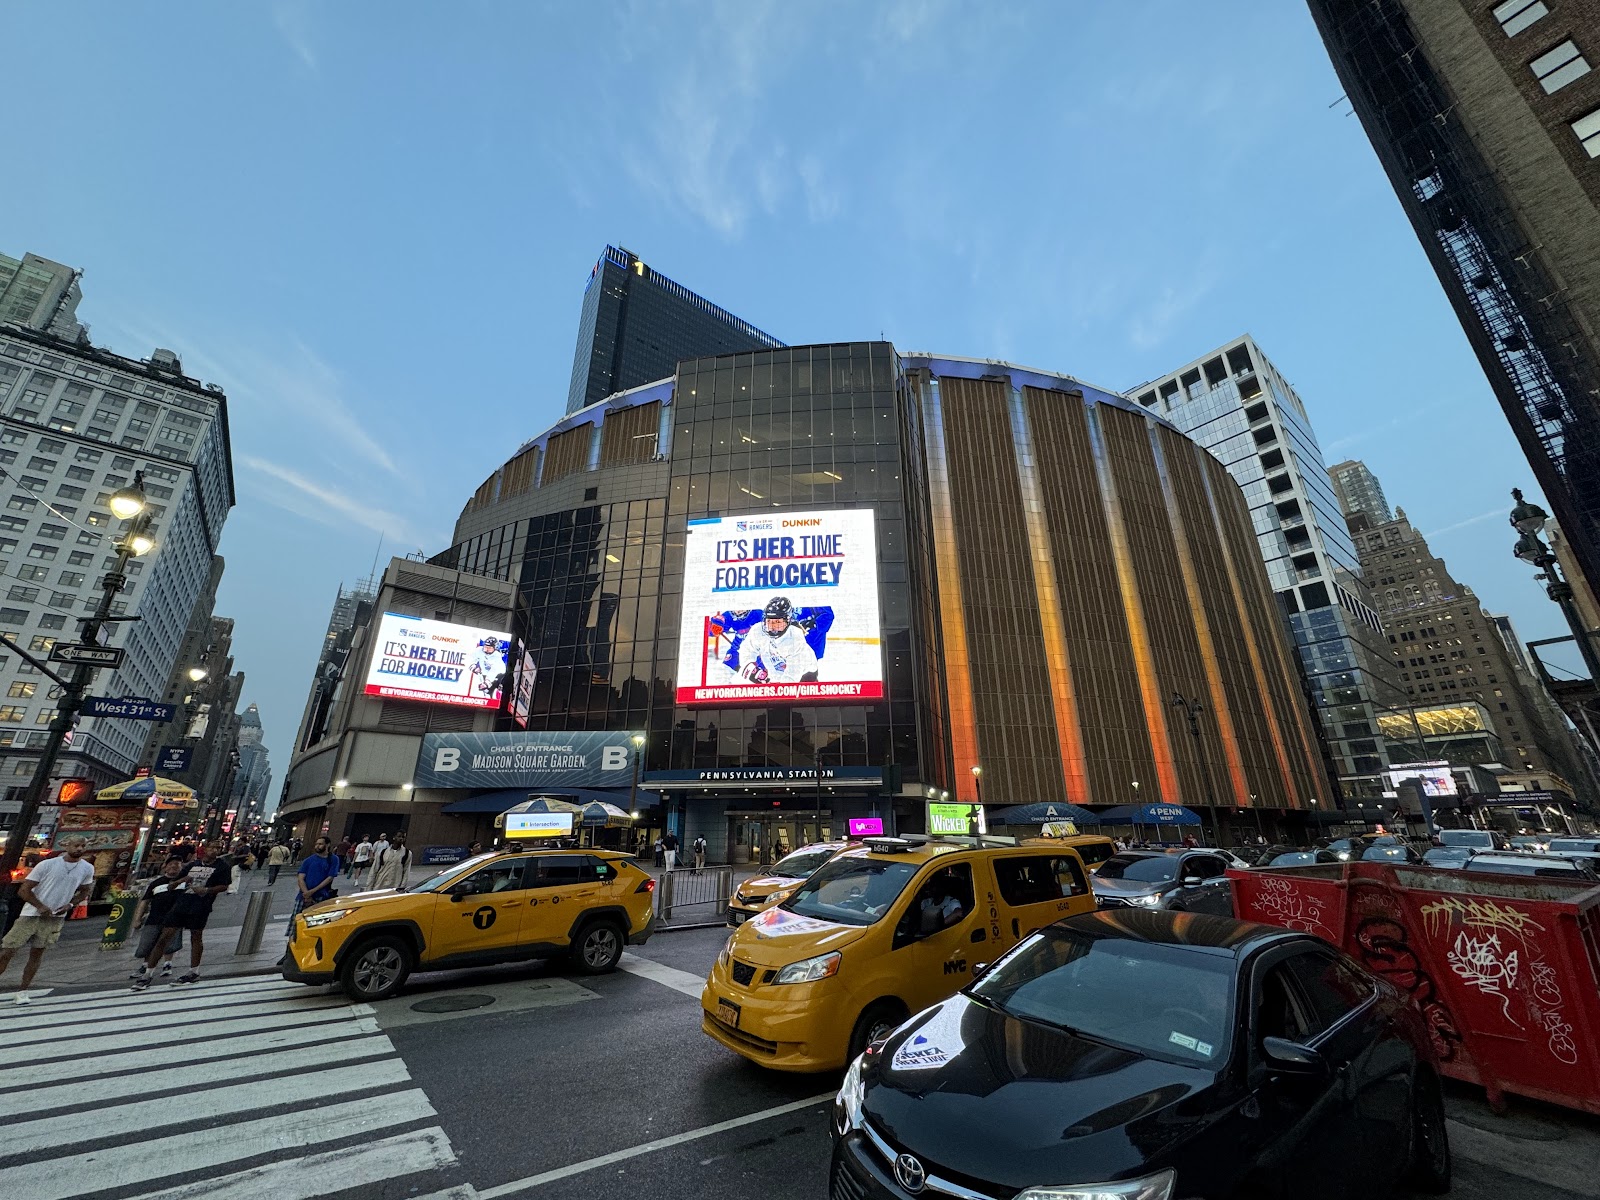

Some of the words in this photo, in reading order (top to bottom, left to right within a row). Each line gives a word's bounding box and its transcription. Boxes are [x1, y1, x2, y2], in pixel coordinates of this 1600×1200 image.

[634, 261, 644, 276] 1
[782, 518, 822, 528] DUNKIN'
[716, 539, 748, 562] IT'S
[753, 536, 794, 559] HER
[800, 534, 842, 557] TIME
[715, 567, 750, 589] FOR
[754, 561, 843, 587] HOCKEY
[432, 634, 460, 644] DUNKIN'
[64, 649, 83, 657] ONE
[384, 641, 407, 657] IT'S
[409, 645, 437, 661] HER
[440, 649, 467, 666] TIME
[380, 658, 405, 673] FOR
[407, 661, 464, 682] HOCKEY
[695, 683, 862, 699] NEWYORKRANGERS.COM/GIRLSHOCKEY
[94, 701, 127, 714] West
[129, 705, 152, 715] 31st
[153, 707, 167, 717] St
[433, 747, 461, 772] B
[471, 754, 512, 769] MADISON
[514, 753, 549, 769] SQUARE
[550, 753, 586, 768] GARDEN
[601, 746, 628, 771] B
[700, 770, 784, 779] PENNSYLVANIA
[1046, 805, 1058, 816] A
[943, 959, 967, 975] NYC
